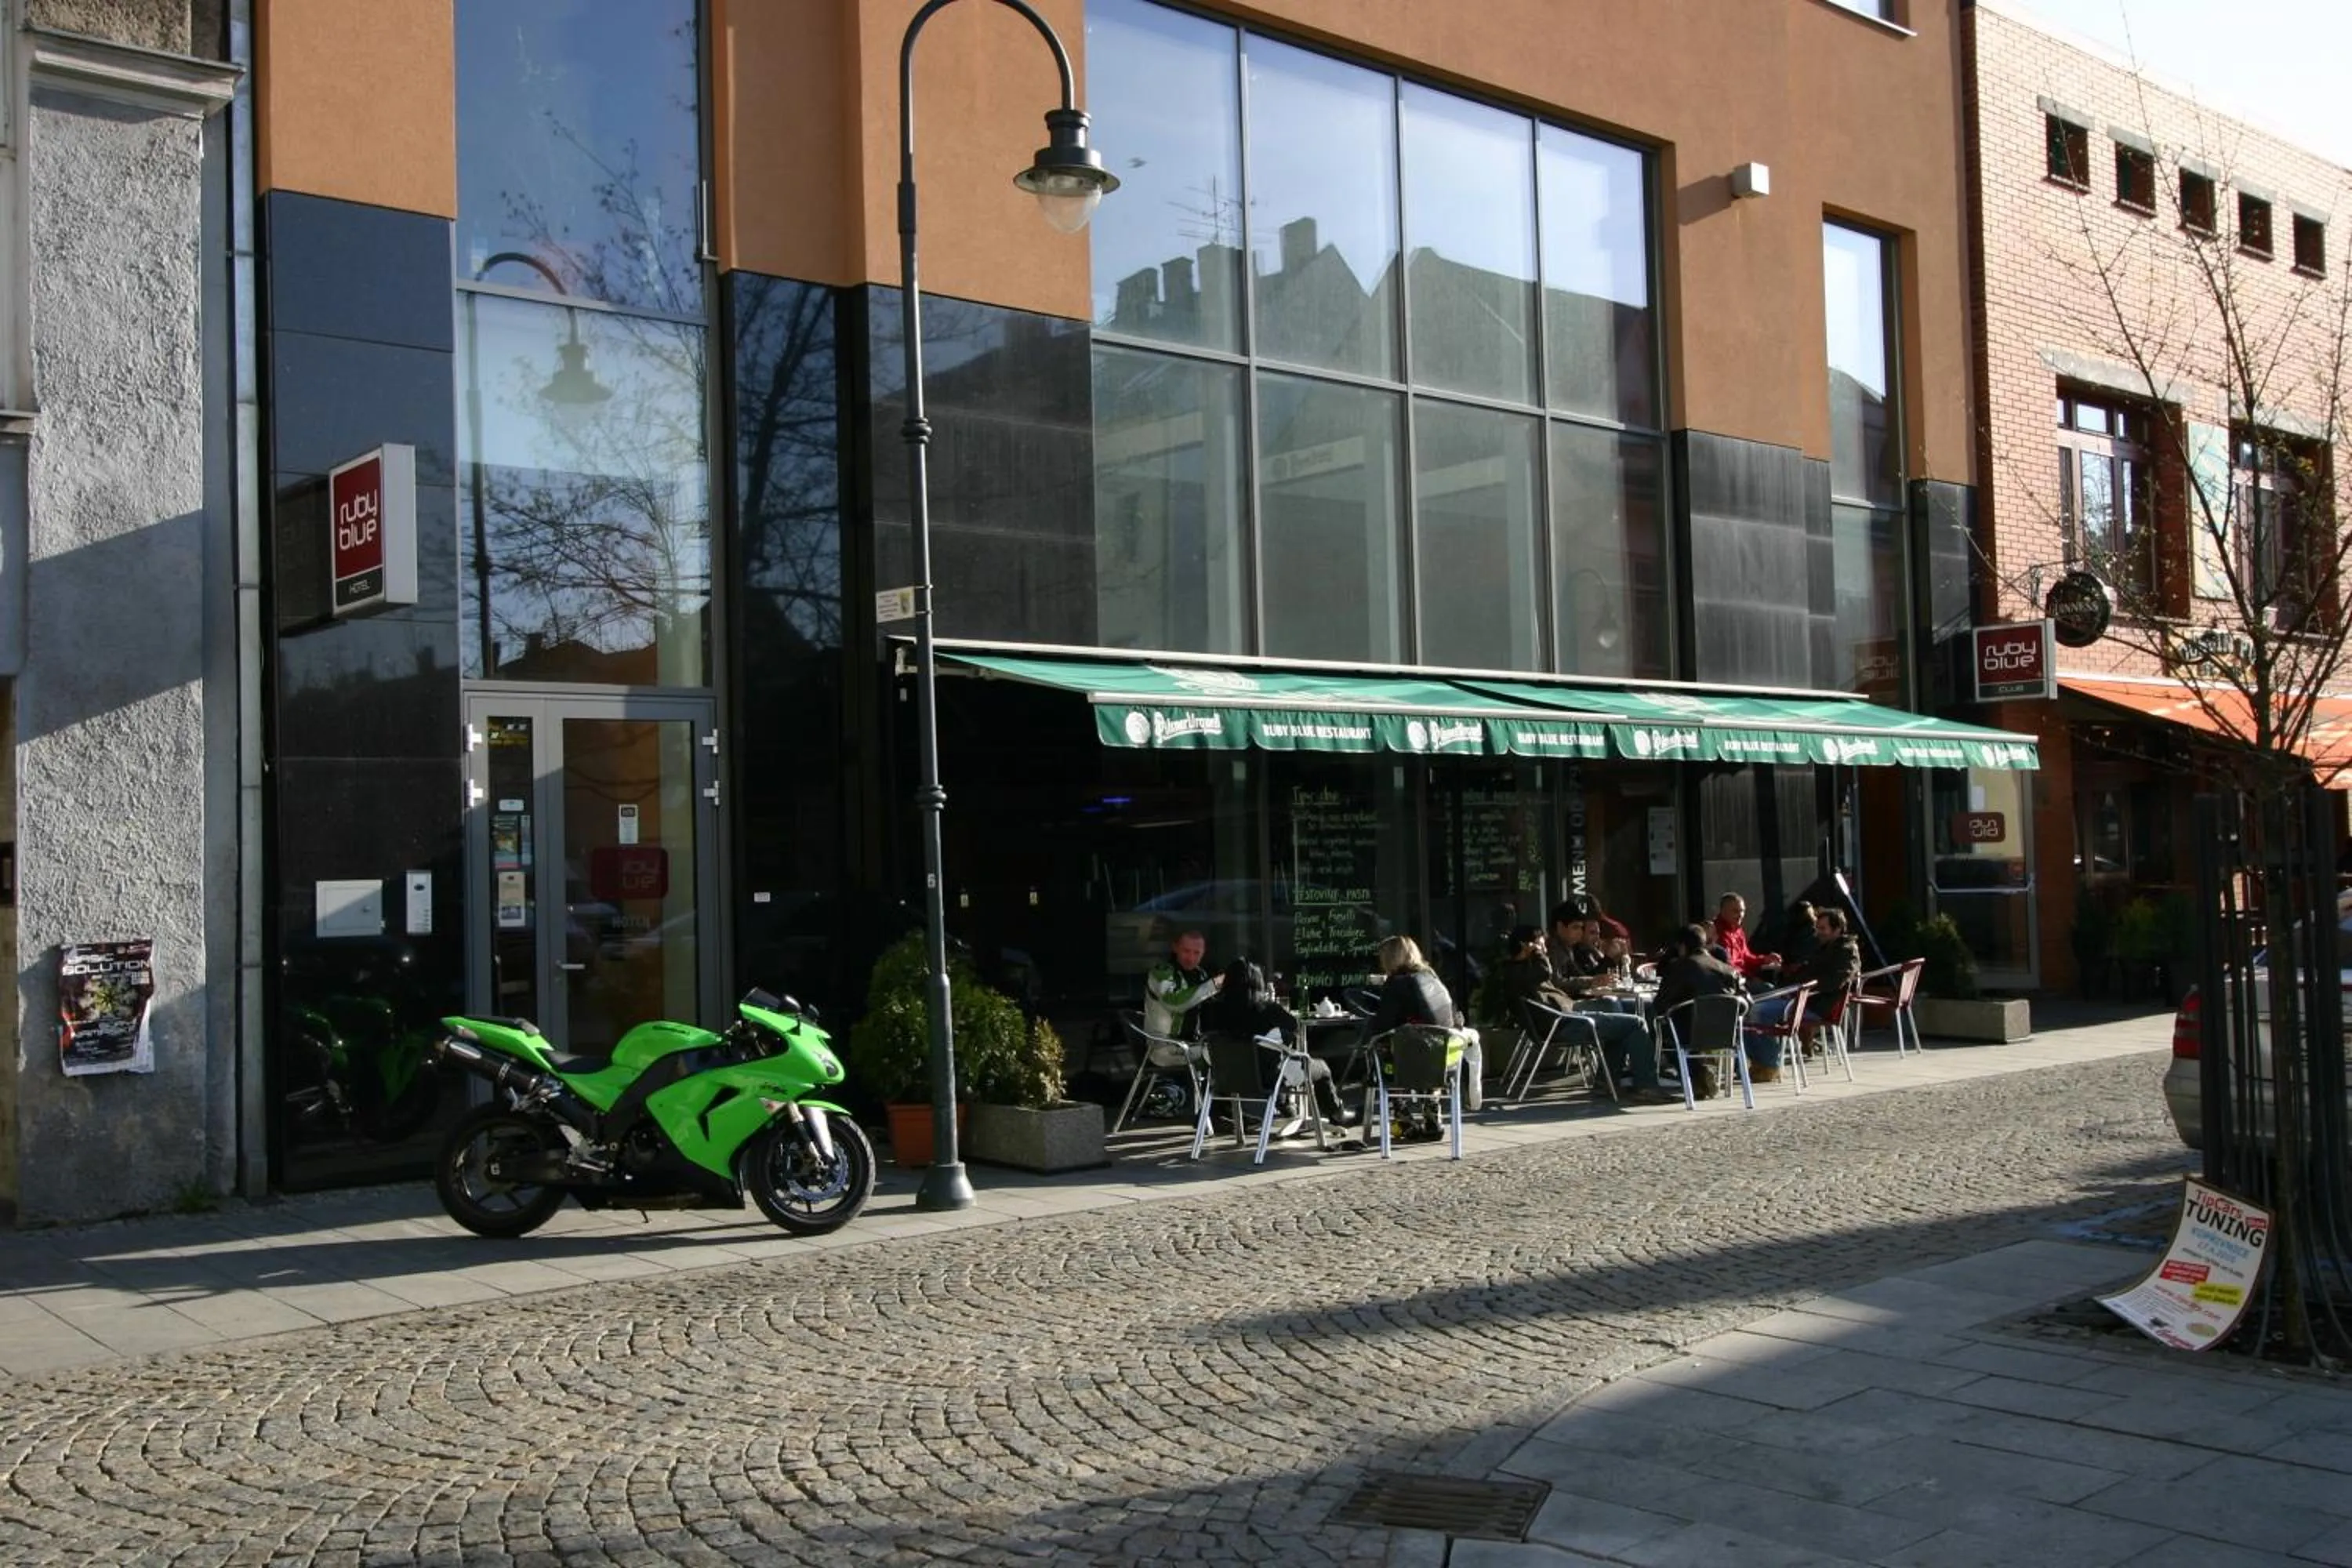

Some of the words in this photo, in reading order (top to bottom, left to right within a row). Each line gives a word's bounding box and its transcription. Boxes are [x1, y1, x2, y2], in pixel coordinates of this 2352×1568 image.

[339, 489, 378, 524] ruby
[339, 519, 377, 550] blue
[1985, 641, 2036, 656] ruby
[1984, 655, 2034, 670] blue
[1261, 724, 1289, 737] RUBY
[62, 960, 151, 976] SOLUTION
[2186, 1199, 2266, 1248] TUNING
